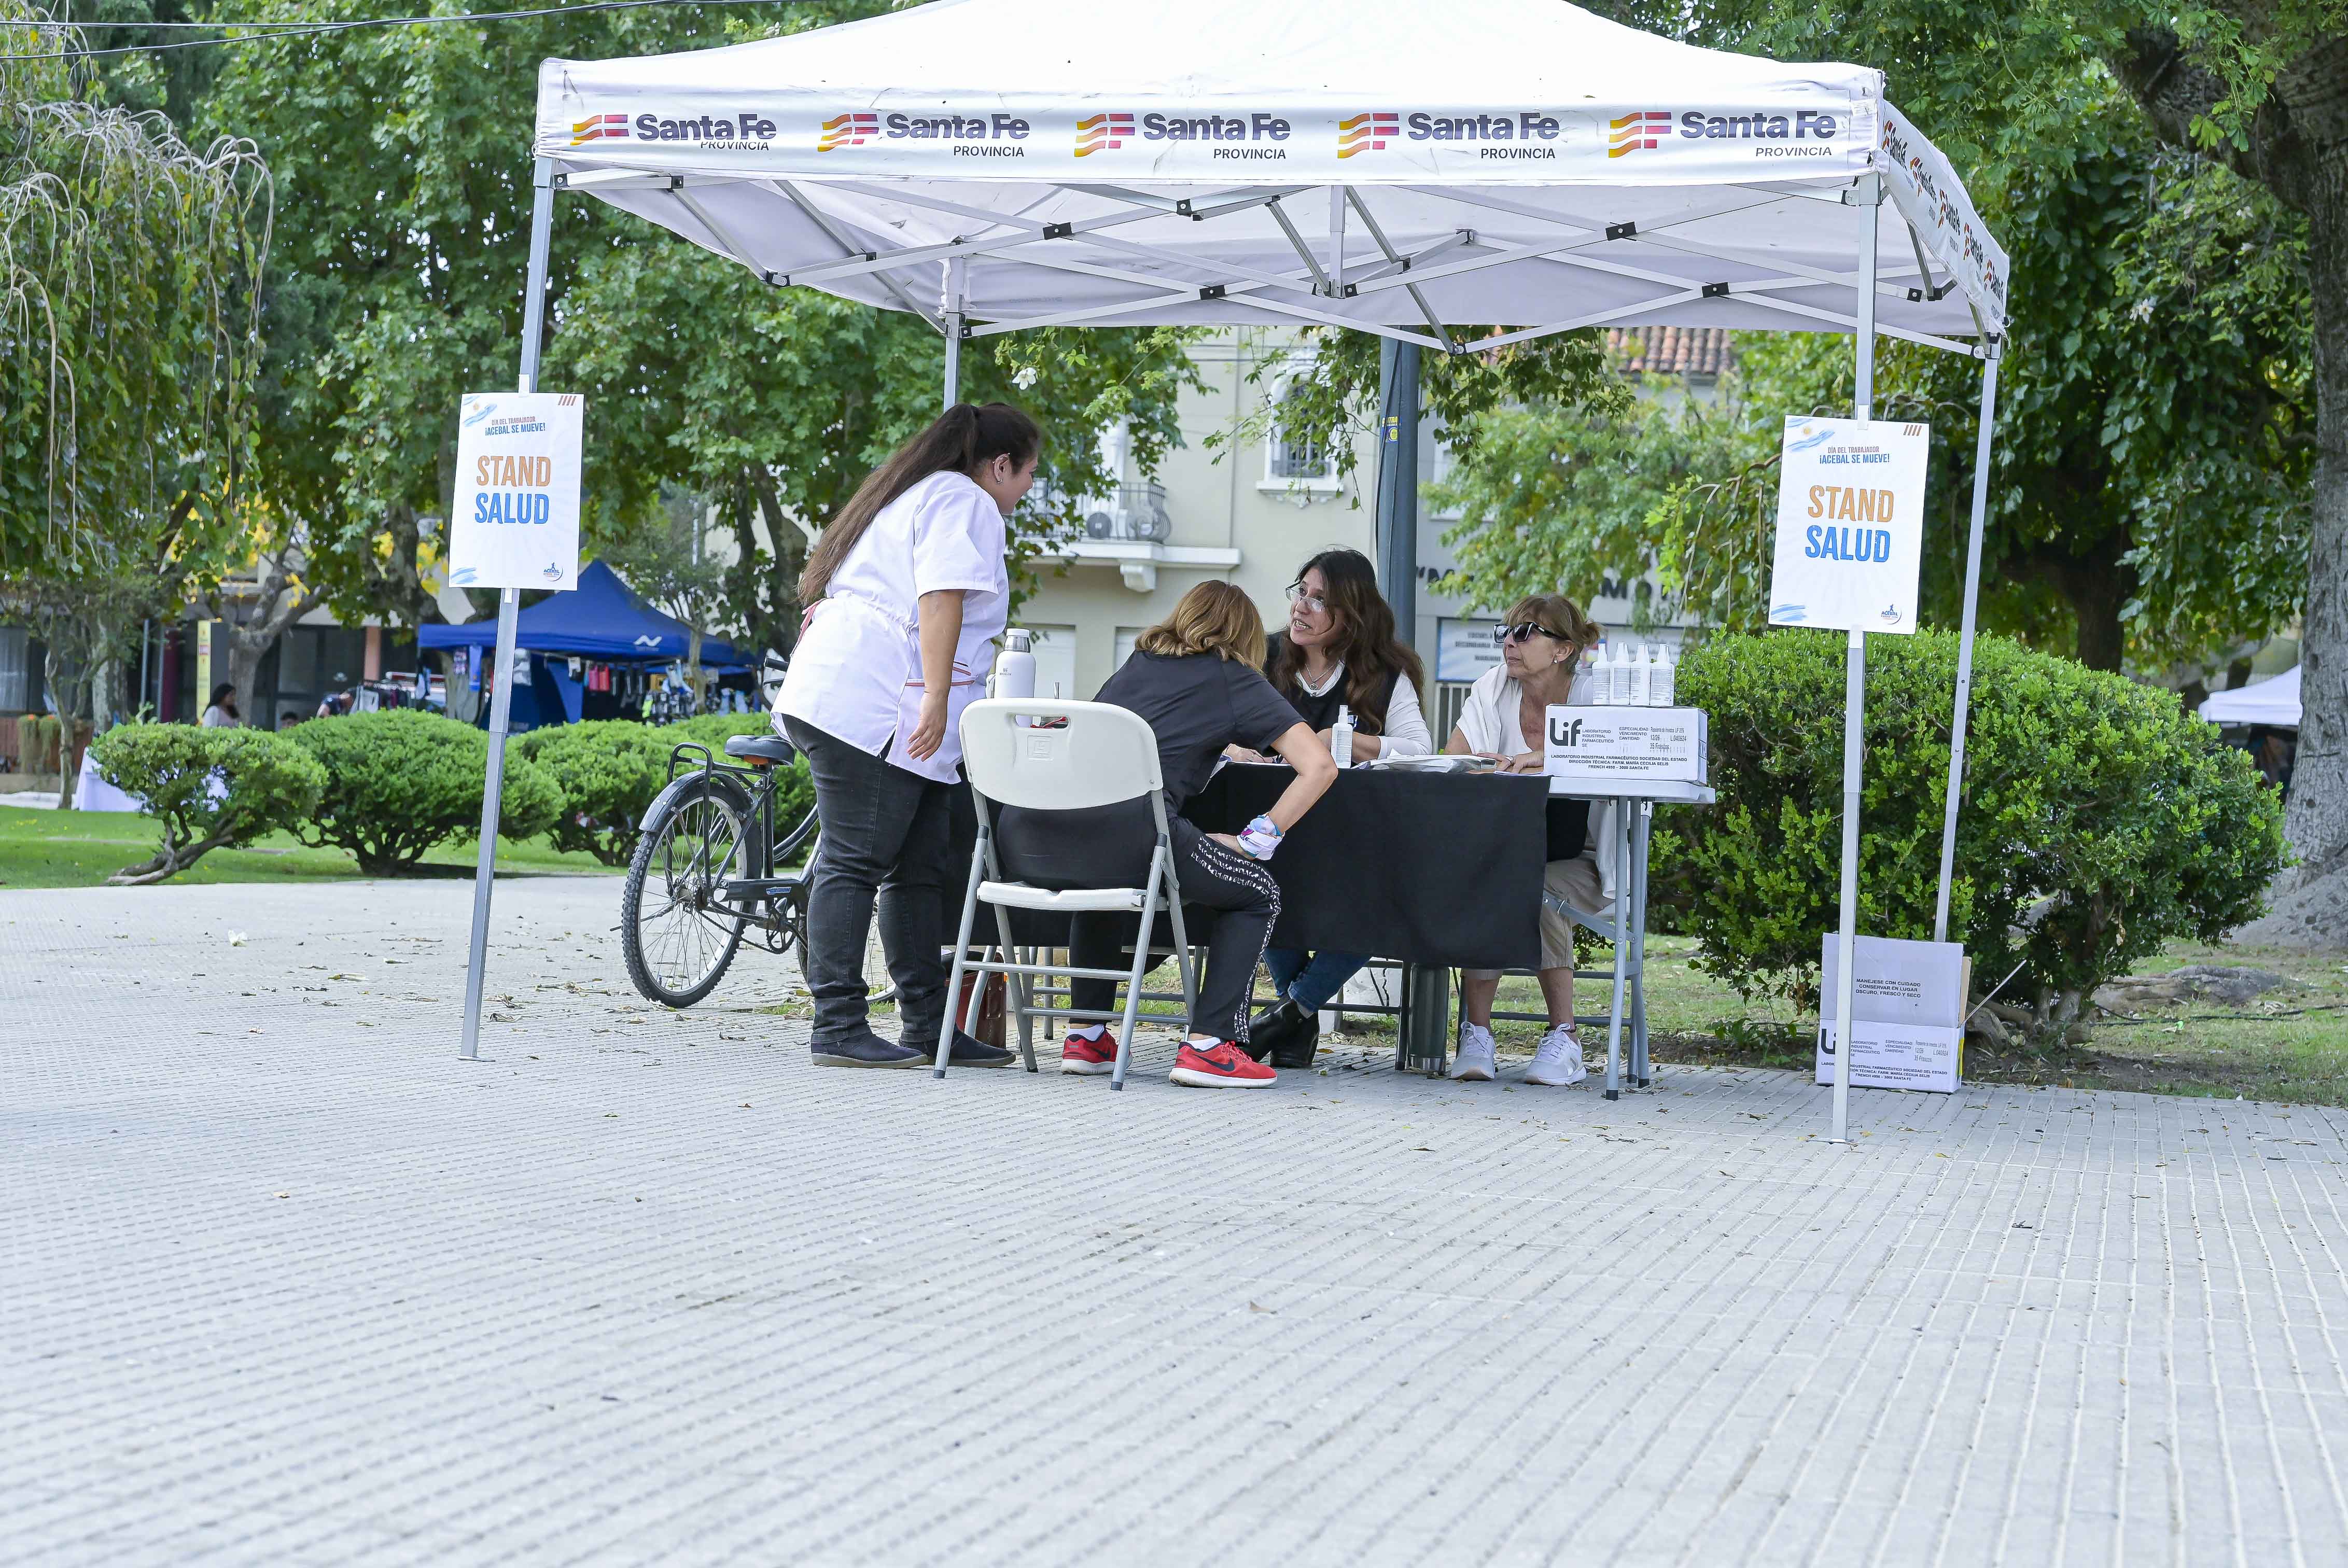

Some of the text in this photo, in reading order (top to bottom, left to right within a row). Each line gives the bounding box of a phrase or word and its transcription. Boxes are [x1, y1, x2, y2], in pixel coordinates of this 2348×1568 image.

[636, 114, 776, 141] Santa Fe
[887, 114, 1030, 139] Santa Fe
[1143, 113, 1291, 141] Santa Fe
[1408, 113, 1559, 140] Santa Fe
[1680, 110, 1836, 138] Santa Fe
[954, 146, 1024, 157] PROVINCIA
[1213, 149, 1286, 159] PROVINCIA
[1480, 148, 1555, 159] PROVINCIA
[1756, 147, 1832, 157] PROVINCIA
[485, 423, 546, 436] ¡ACEBAL SE MUEVE!
[508, 416, 536, 424] TRABAJADOR
[477, 456, 551, 487] STAND
[1820, 453, 1890, 464] ¡ACEBAL SE MUEVE!
[474, 493, 549, 524] SALUD
[1808, 485, 1894, 522] STAND
[1805, 525, 1890, 563] SALUD
